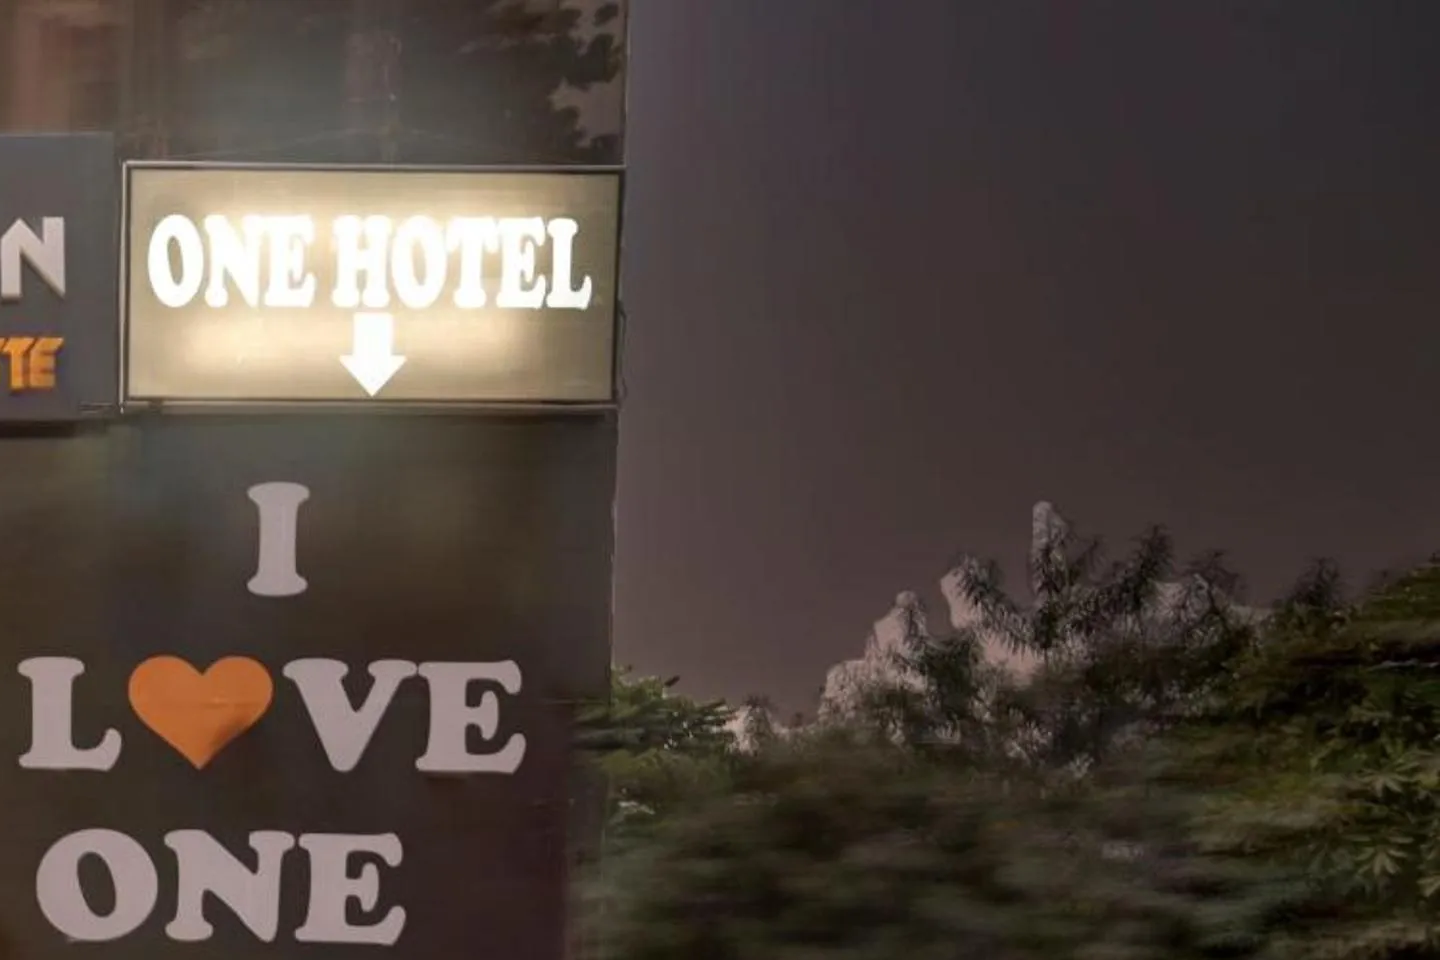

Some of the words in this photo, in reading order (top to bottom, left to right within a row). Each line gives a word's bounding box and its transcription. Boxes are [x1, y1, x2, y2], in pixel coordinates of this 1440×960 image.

[147, 214, 317, 308] ONE
[332, 214, 592, 309] HOTEL
[246, 481, 310, 597] I
[17, 655, 527, 774] LVE
[36, 828, 406, 946] ONE
